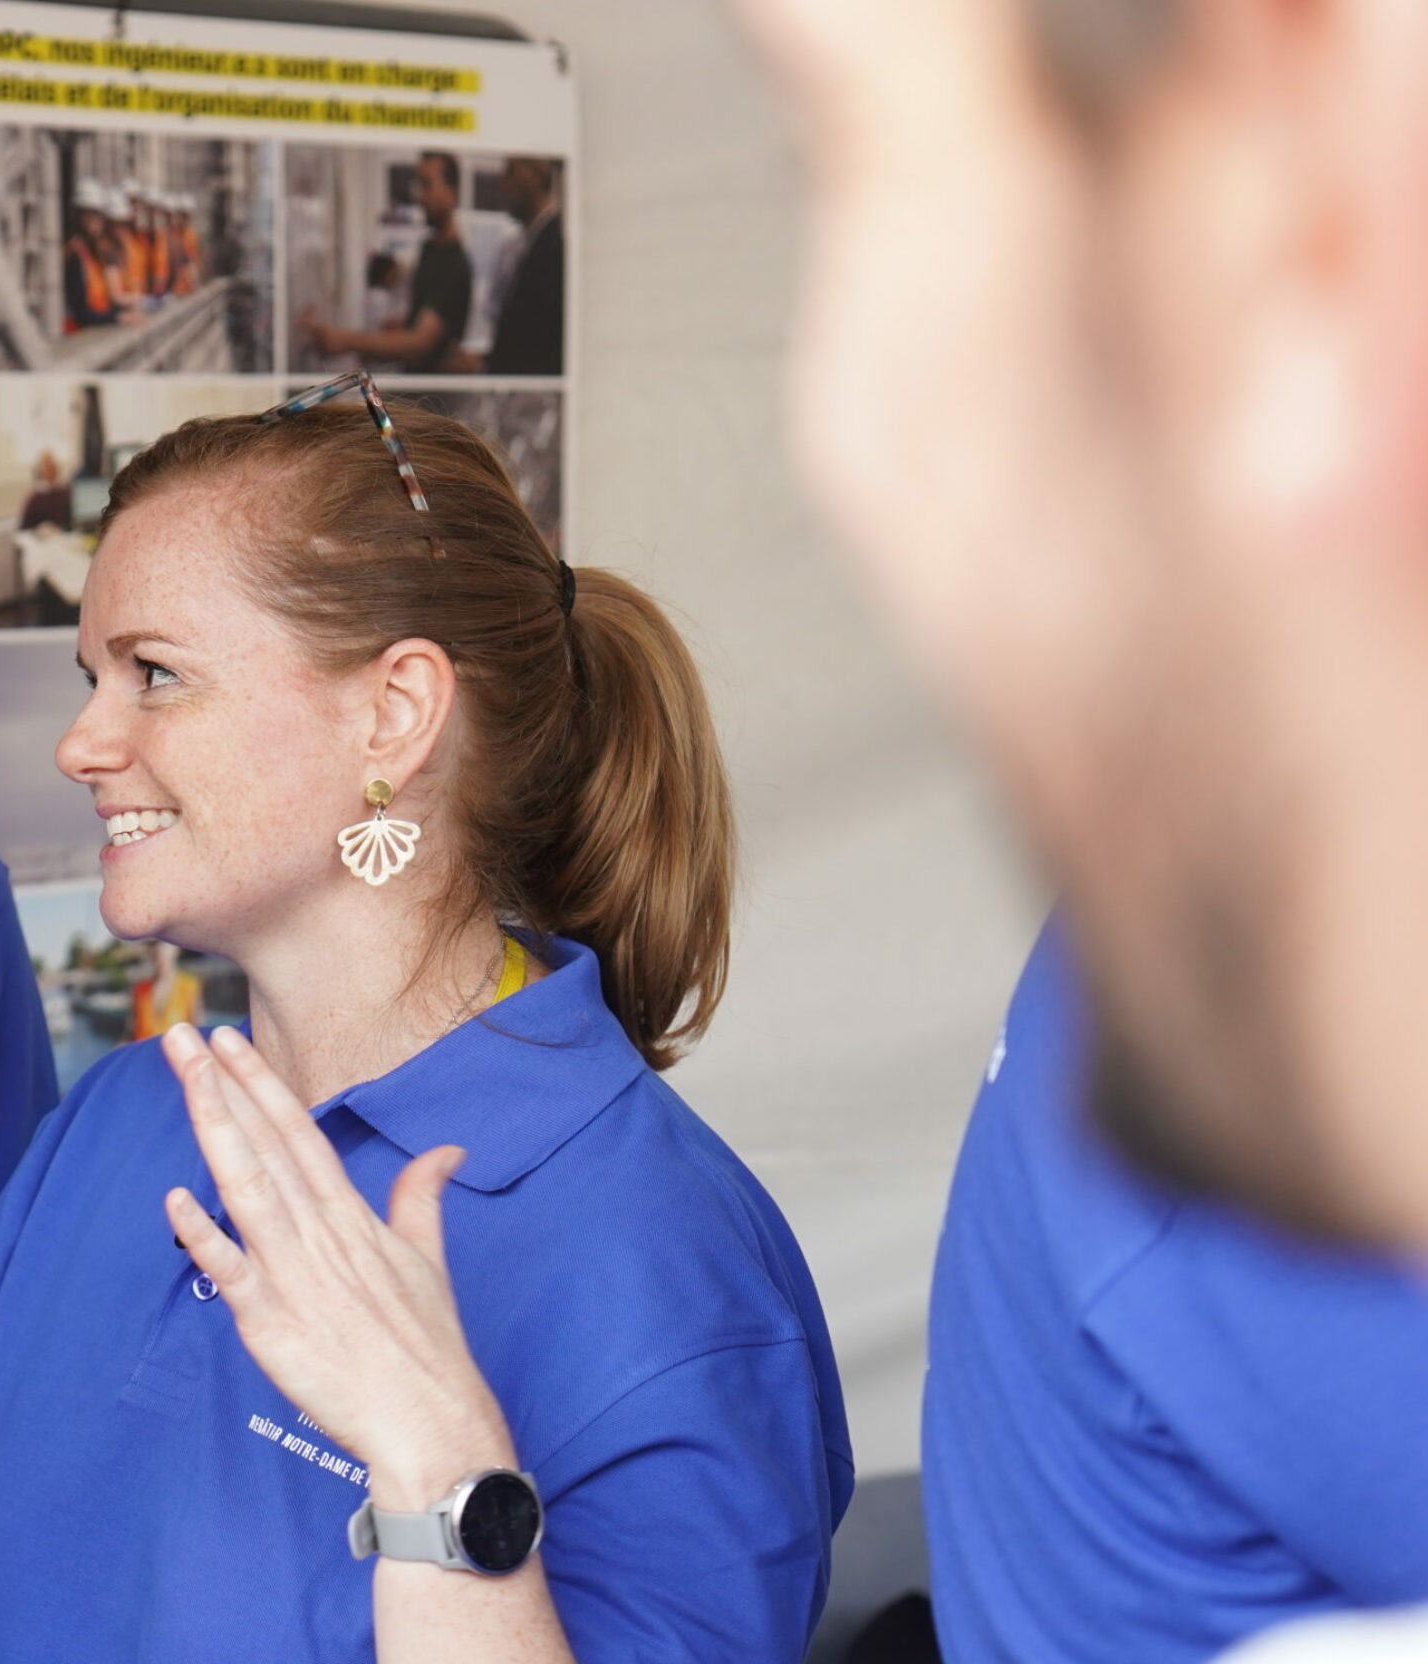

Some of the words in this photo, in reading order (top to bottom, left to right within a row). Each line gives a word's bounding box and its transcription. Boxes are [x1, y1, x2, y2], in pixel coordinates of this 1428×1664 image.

[49, 38, 94, 64] nos
[276, 52, 330, 82] sont
[341, 63, 364, 84] en
[376, 58, 456, 98] charge
[68, 79, 90, 105] et
[101, 80, 128, 107] de
[324, 93, 351, 121] du
[363, 96, 461, 128] chantier
[247, 1414, 283, 1442] REBÂTIR
[281, 1433, 353, 1478] NOTRE-DAME
[349, 1467, 368, 1485] DE
